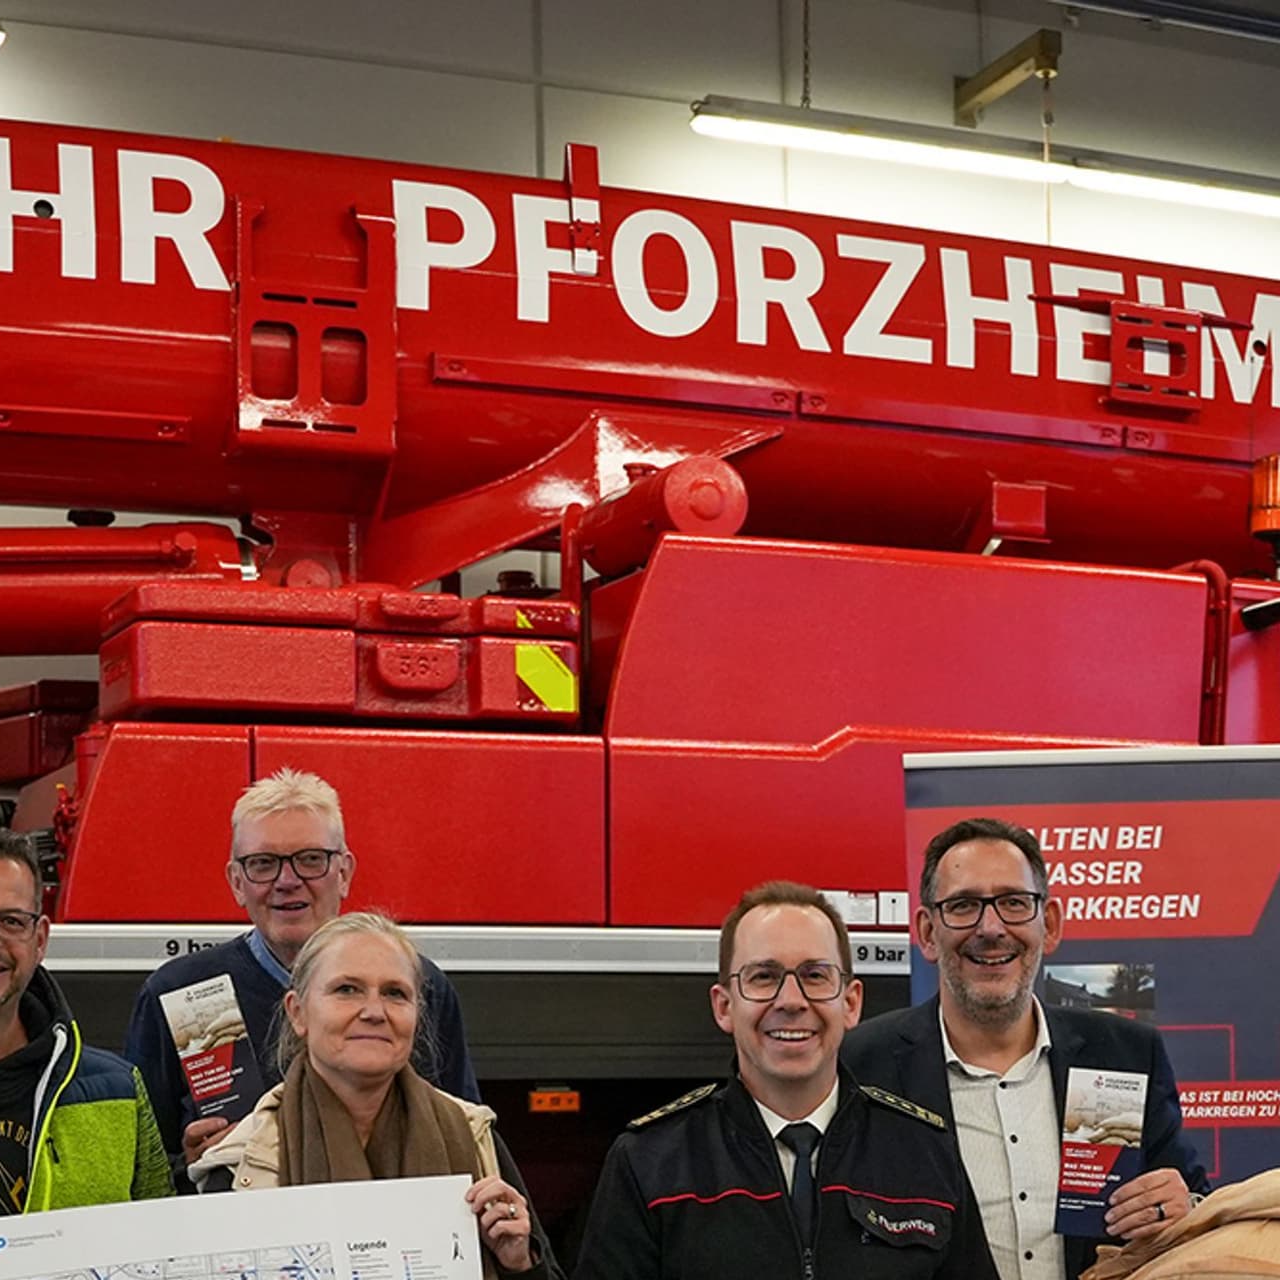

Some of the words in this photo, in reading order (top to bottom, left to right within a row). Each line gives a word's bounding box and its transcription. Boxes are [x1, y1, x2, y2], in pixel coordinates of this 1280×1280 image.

[1115, 825, 1163, 850] BEI
[166, 940, 180, 956] 9
[857, 945, 868, 961] 9
[875, 945, 906, 962] bar
[1199, 1091, 1220, 1103] IST
[1223, 1090, 1244, 1102] BEI
[1258, 1104, 1277, 1117] ZU
[347, 1240, 388, 1254] Legende
